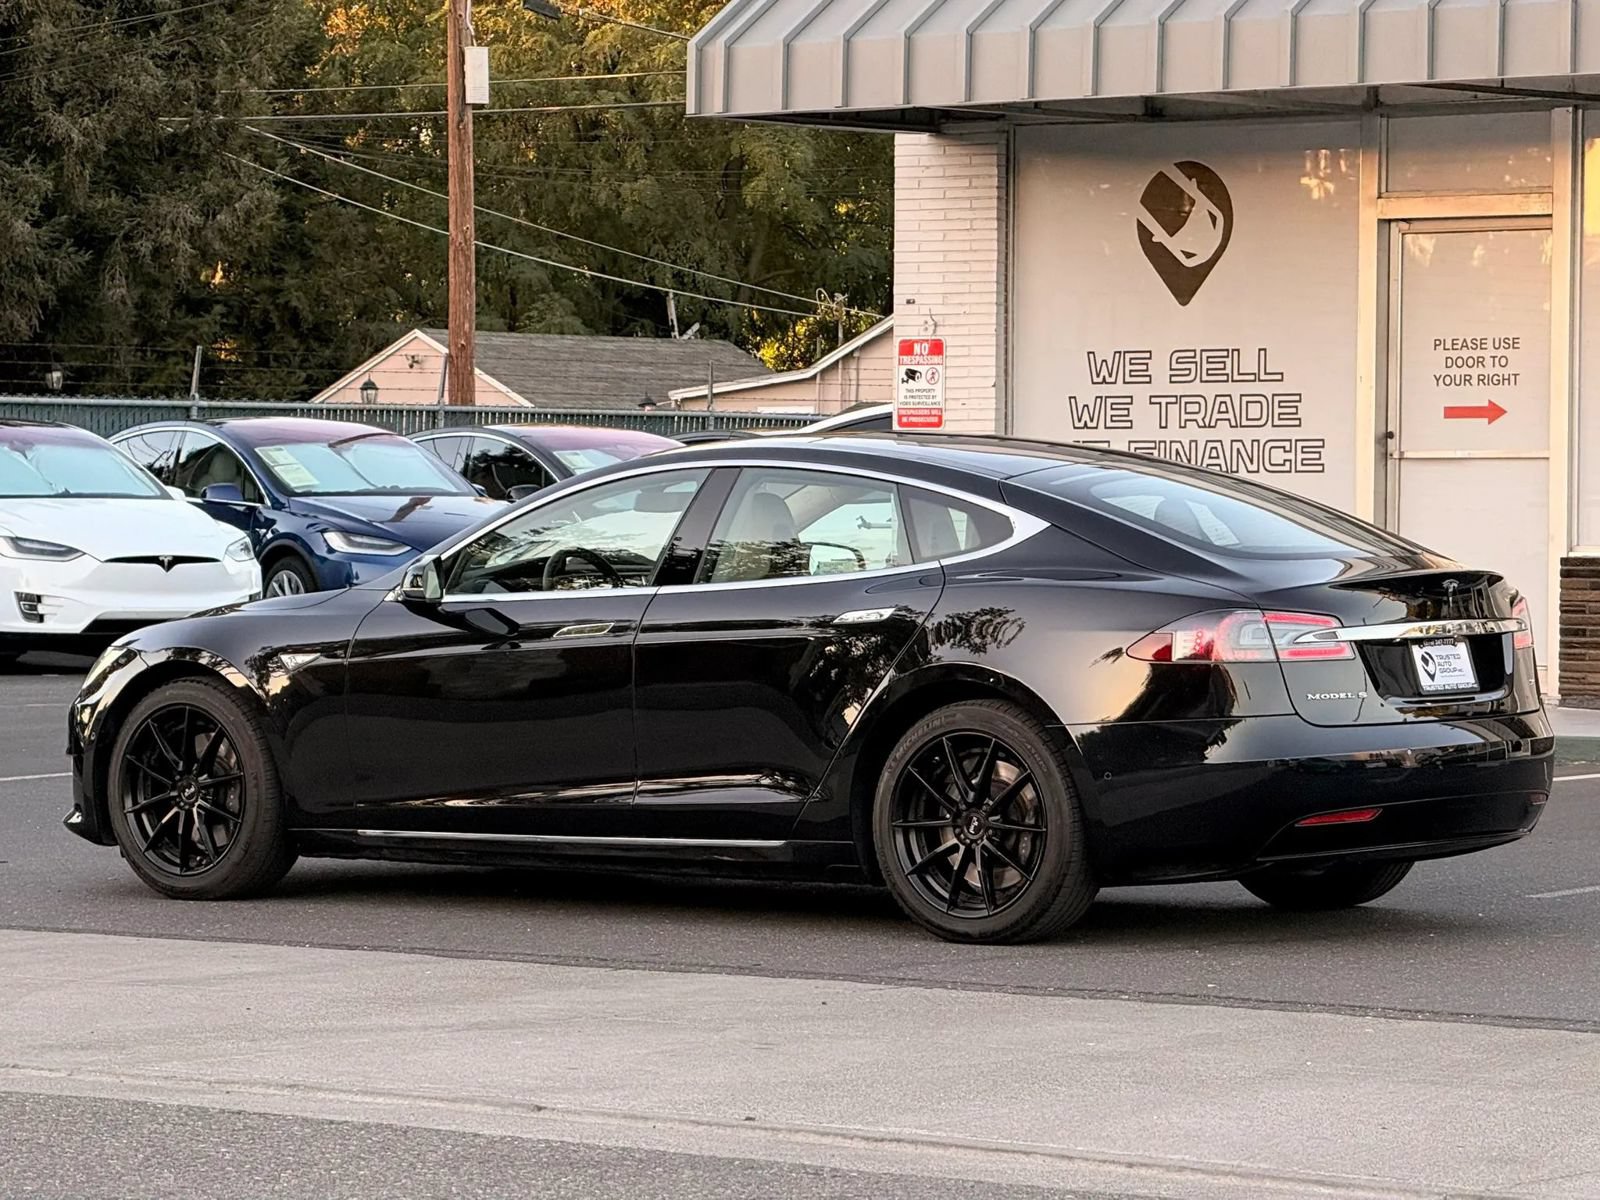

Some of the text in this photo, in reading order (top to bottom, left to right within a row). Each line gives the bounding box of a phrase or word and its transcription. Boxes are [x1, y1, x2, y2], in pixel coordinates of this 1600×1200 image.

[913, 342, 929, 355] NO
[1433, 337, 1520, 351] PLEASE USE
[899, 356, 943, 365] TRESPASSING
[1087, 348, 1284, 384] WE SELL
[1445, 355, 1509, 368] DOOR TO
[1433, 373, 1520, 387] YOUR RIGHT
[1068, 393, 1302, 429] WE TRADE
[1306, 691, 1368, 700] MODEL S
